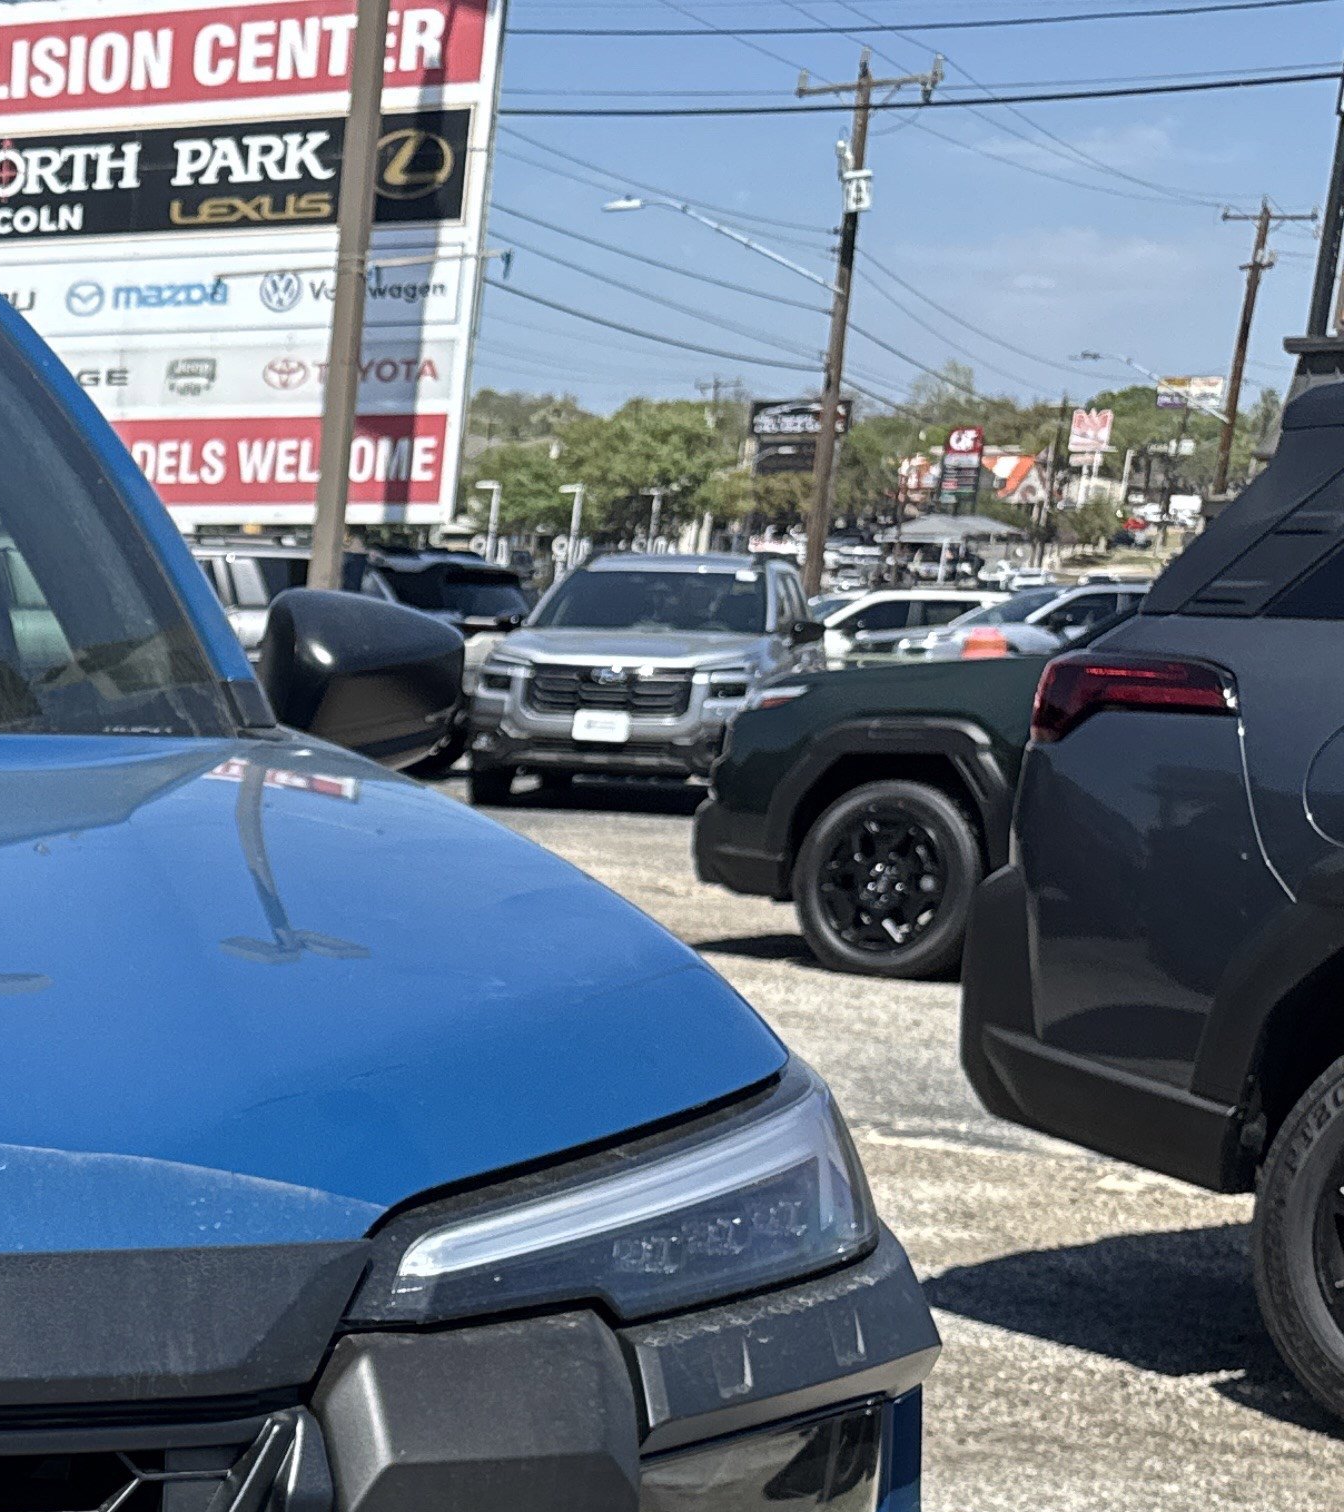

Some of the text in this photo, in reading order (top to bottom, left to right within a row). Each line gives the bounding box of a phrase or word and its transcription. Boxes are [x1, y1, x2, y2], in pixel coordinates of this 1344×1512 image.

[170, 130, 336, 187] PARK
[169, 190, 333, 225] LEXUS
[112, 280, 229, 310] mazda
[309, 277, 446, 304] Vowagen
[313, 358, 439, 384] TYOTA
[130, 435, 438, 485] DELS WELOME
